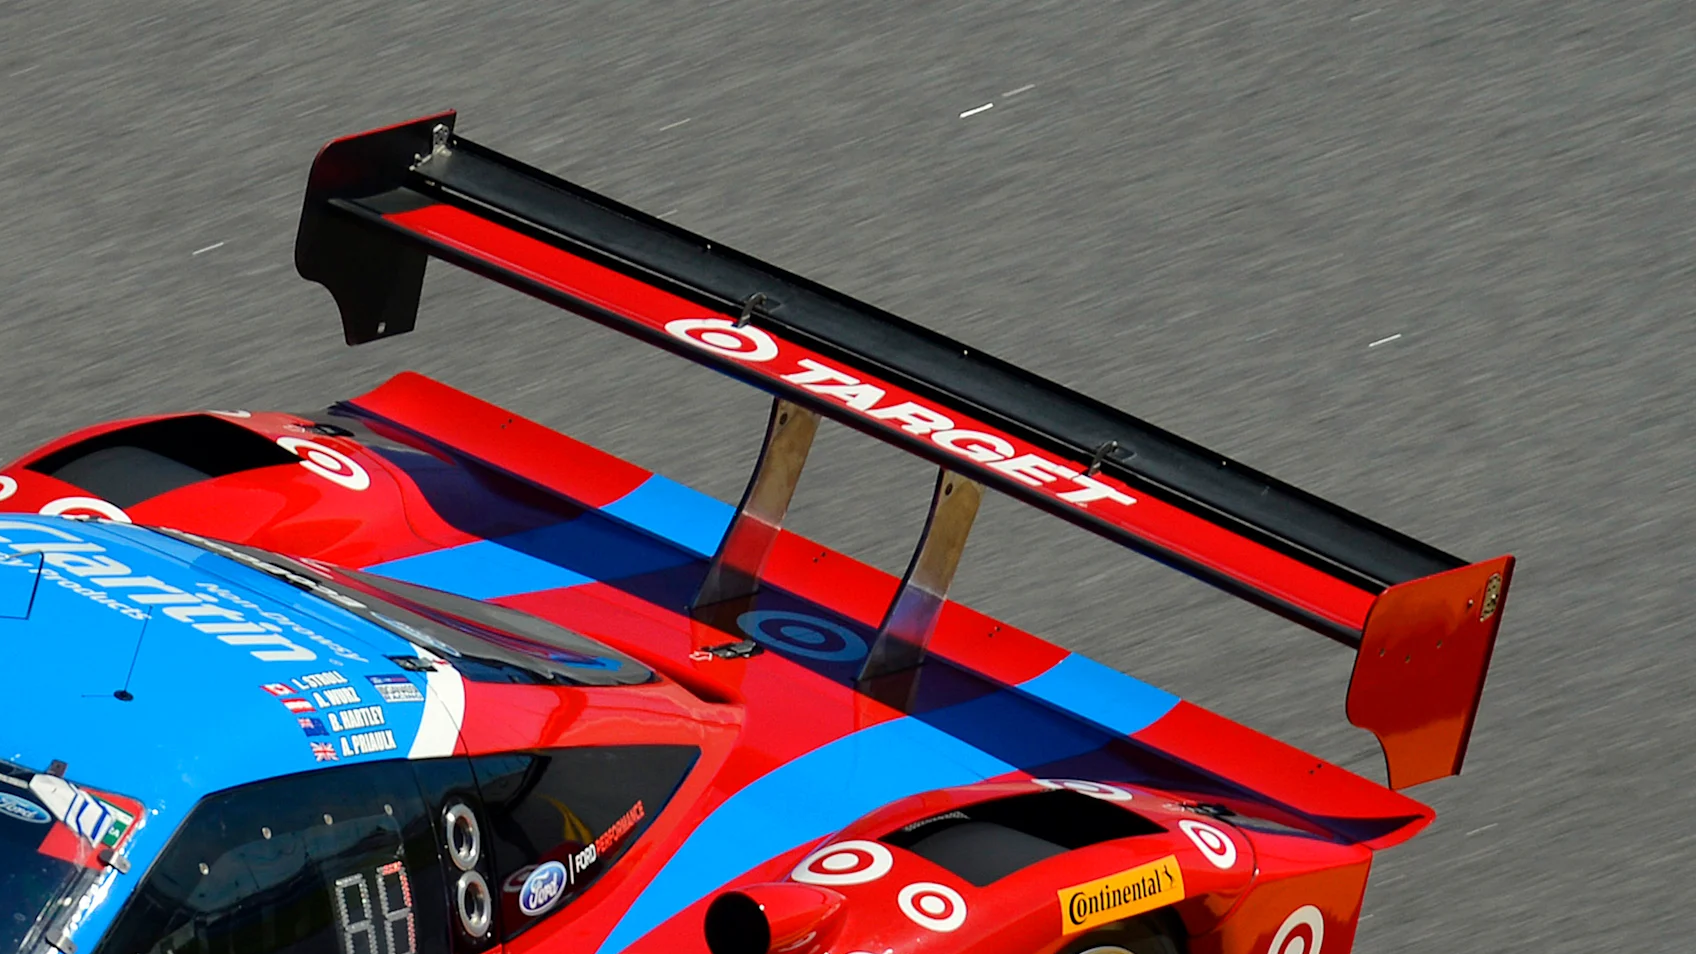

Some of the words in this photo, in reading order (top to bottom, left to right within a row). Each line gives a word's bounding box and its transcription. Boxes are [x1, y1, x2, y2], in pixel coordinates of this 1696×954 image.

[780, 358, 1137, 507] TARGET
[574, 844, 597, 873] FORD
[595, 800, 645, 856] PERFORMANCE
[1068, 868, 1162, 925] Continental
